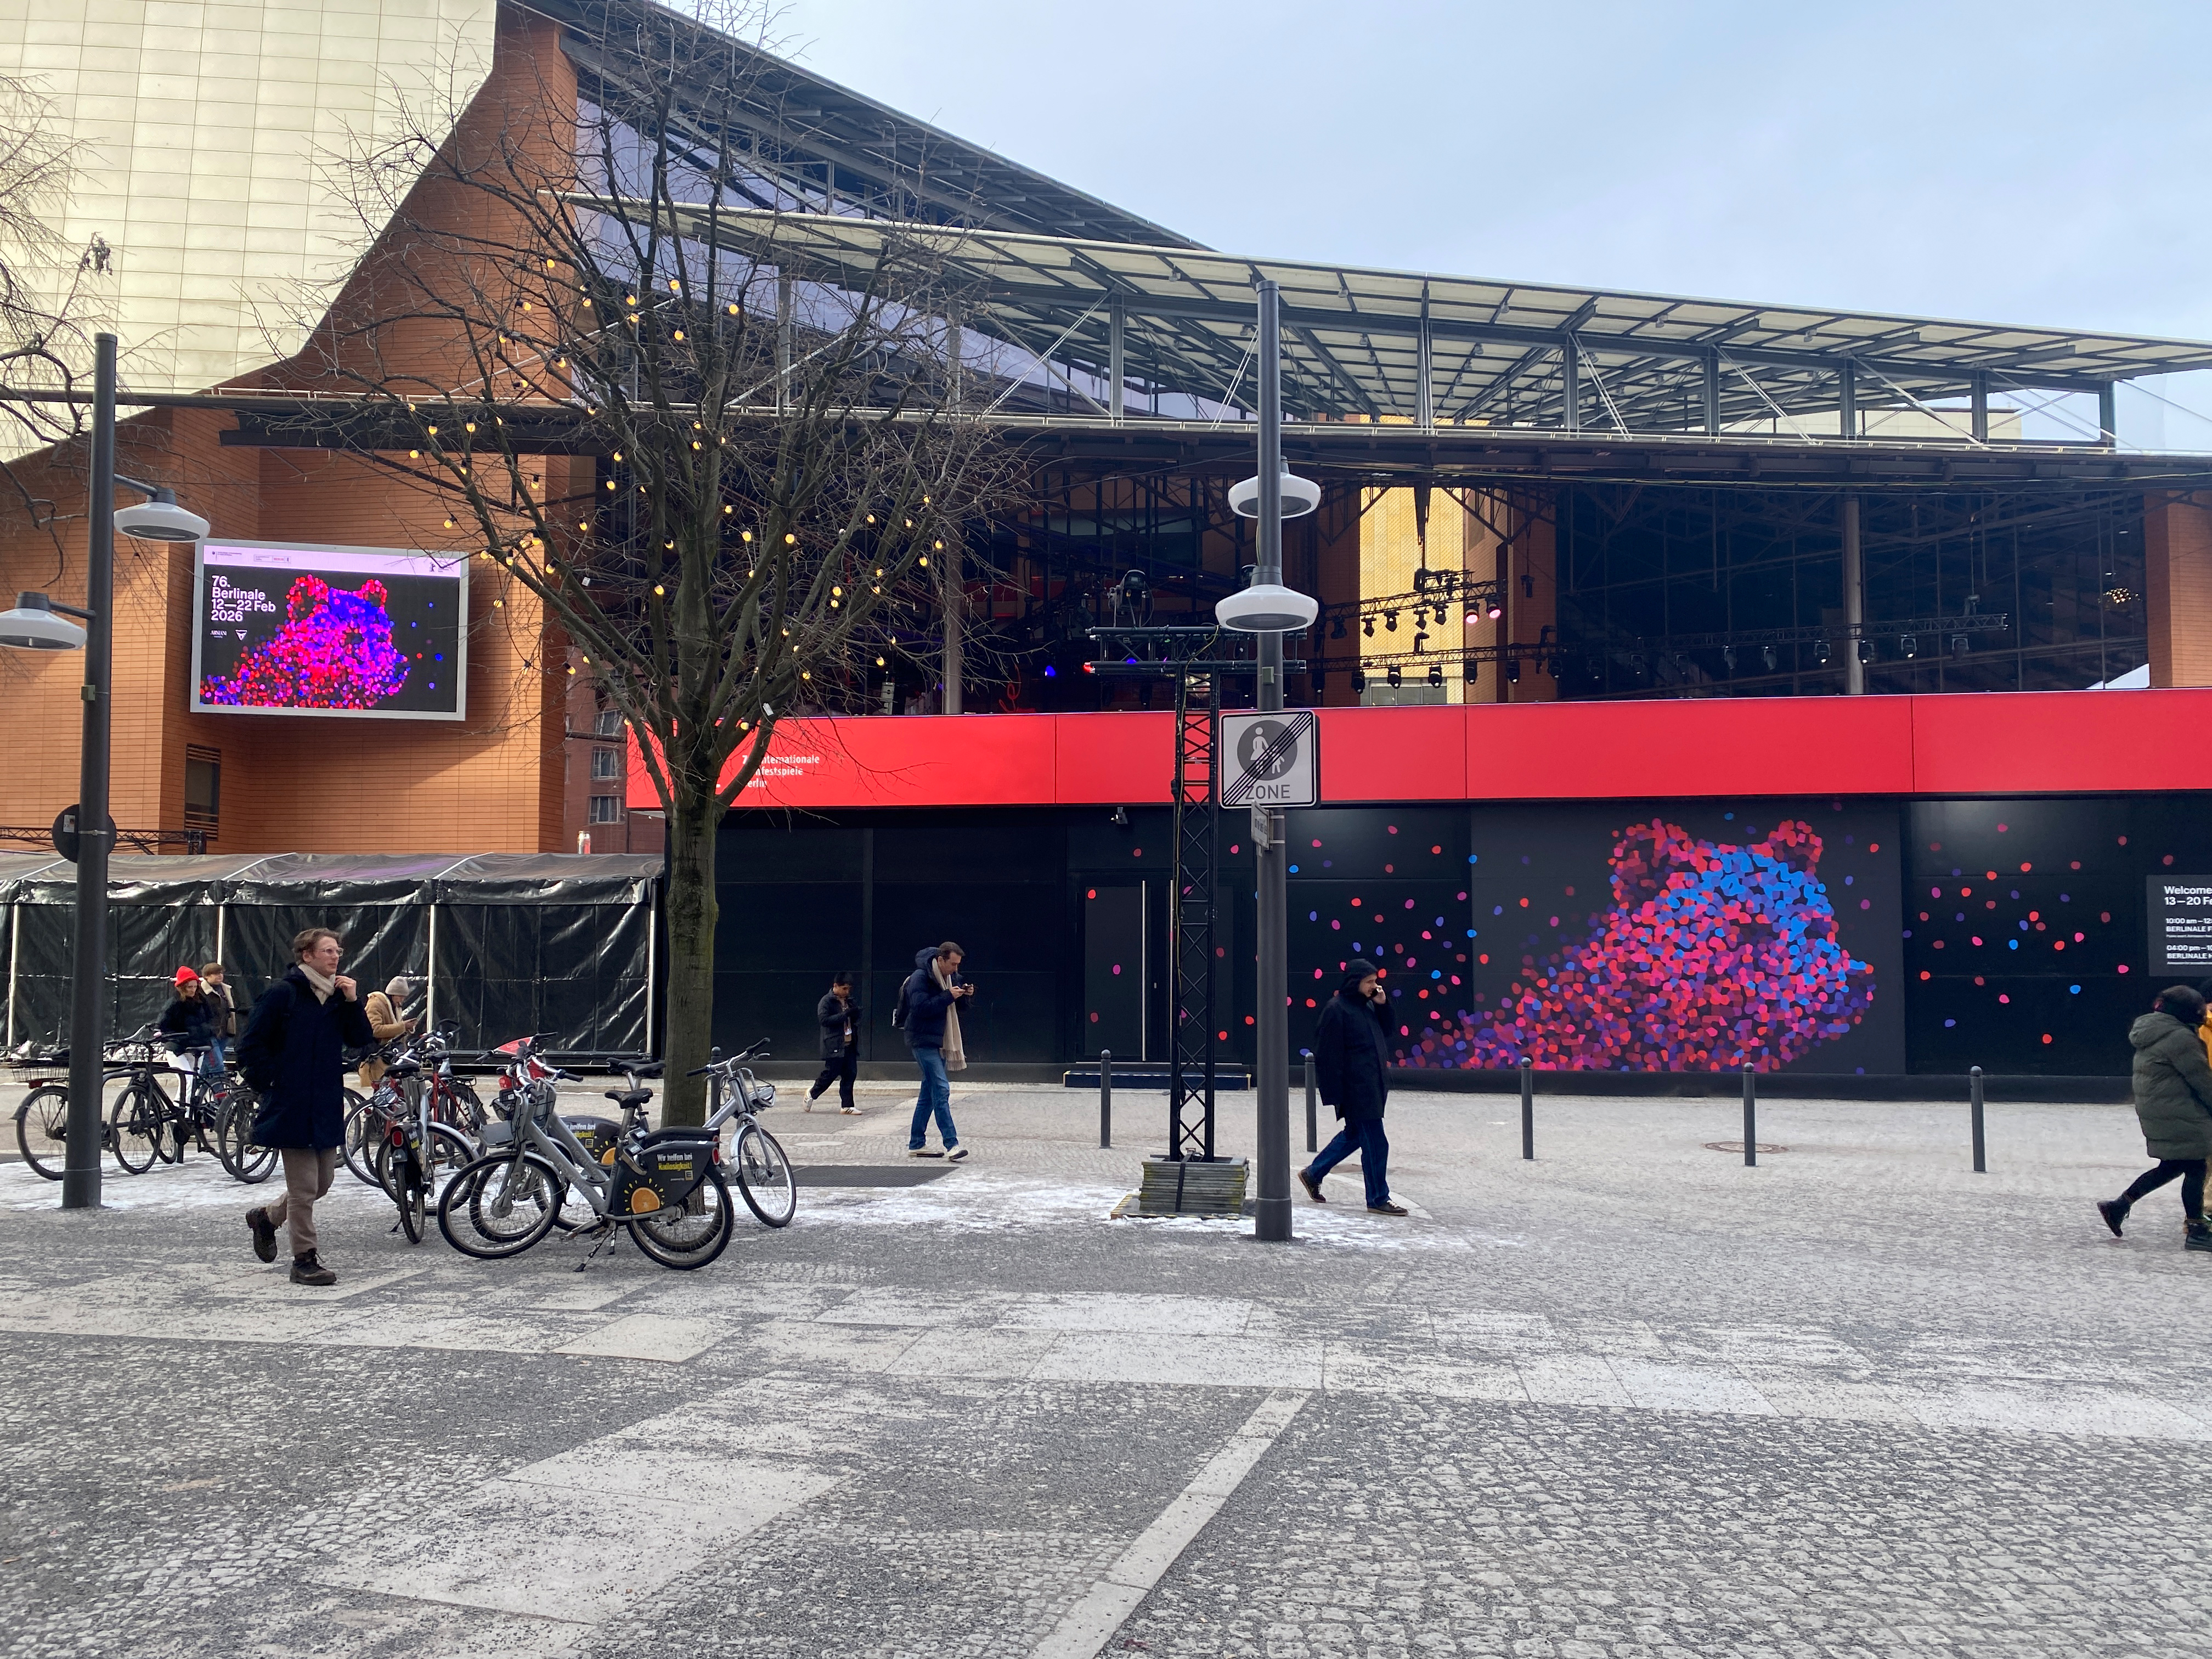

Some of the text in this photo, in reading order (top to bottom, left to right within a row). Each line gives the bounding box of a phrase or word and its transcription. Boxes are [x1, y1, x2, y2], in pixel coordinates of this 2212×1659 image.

[212, 575, 230, 588] 76.
[212, 586, 266, 601] Berlinale
[253, 600, 276, 612] Feb
[211, 609, 244, 622] 2026
[761, 754, 820, 764] nternationale
[747, 777, 768, 787] erlin
[1245, 785, 1290, 800] ZONE
[2164, 885, 2212, 894] Welcome
